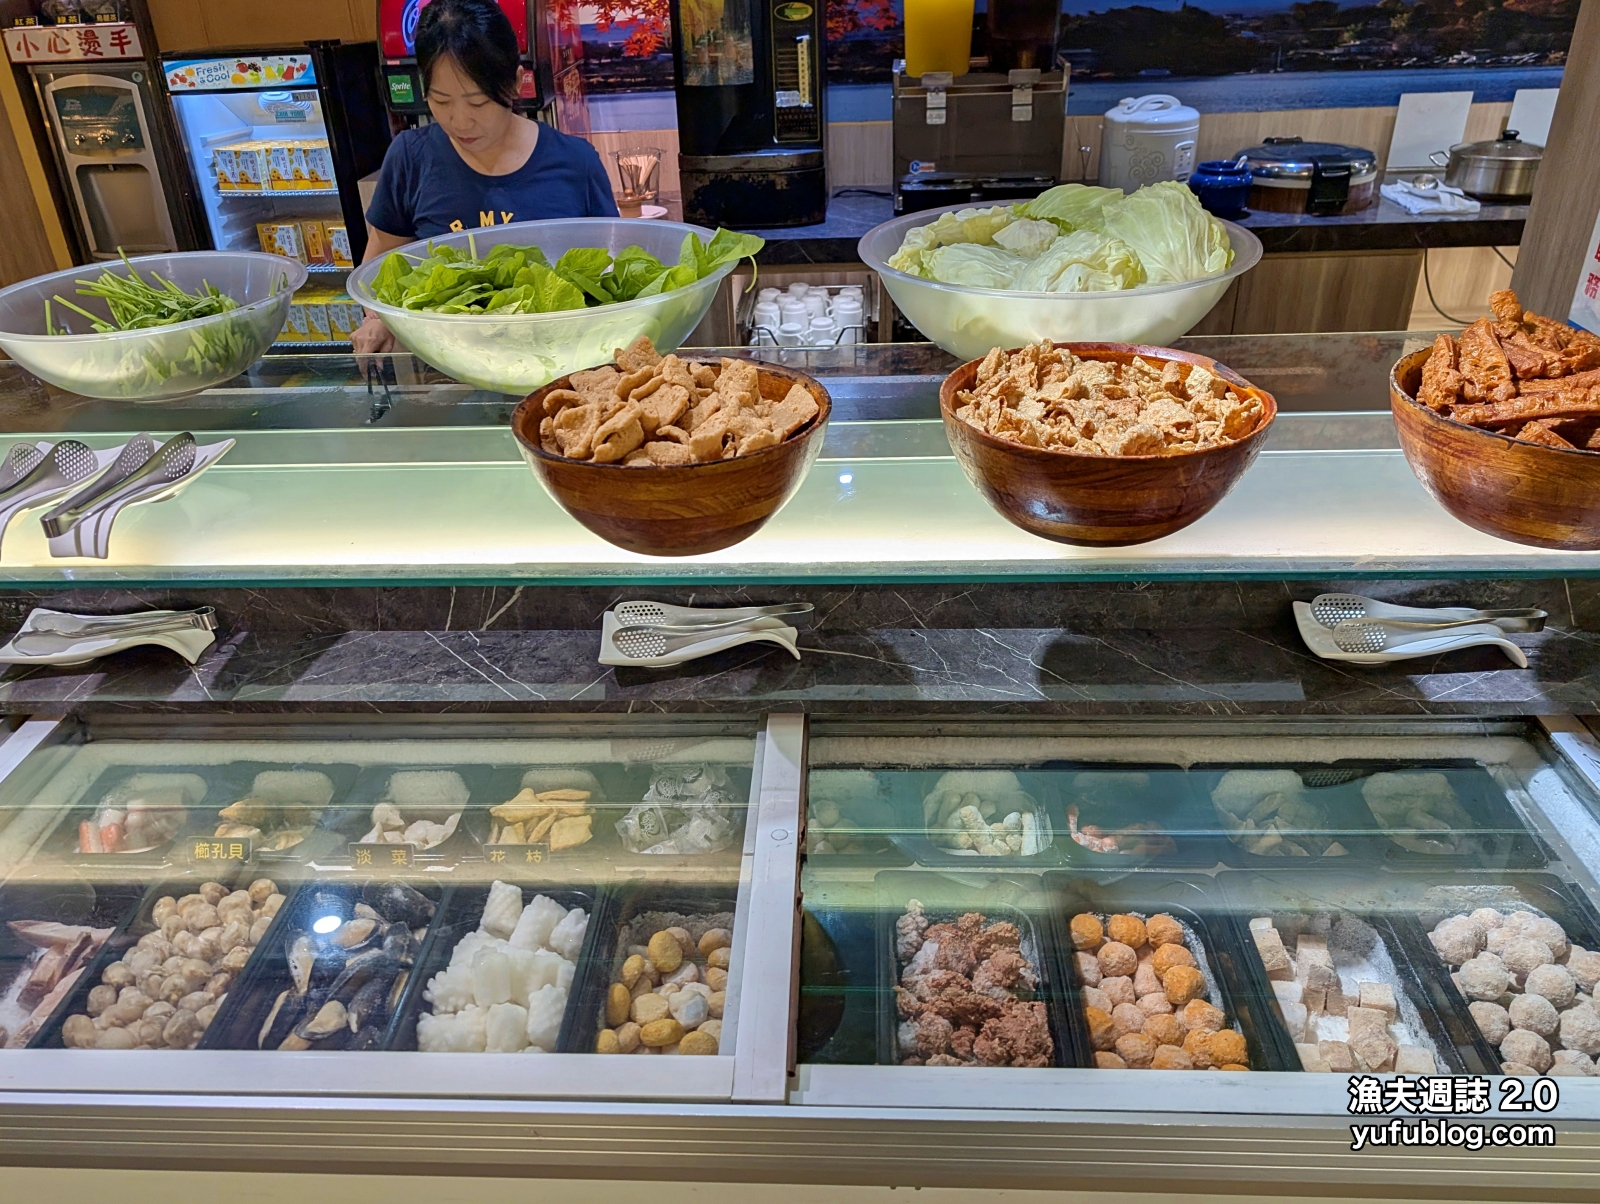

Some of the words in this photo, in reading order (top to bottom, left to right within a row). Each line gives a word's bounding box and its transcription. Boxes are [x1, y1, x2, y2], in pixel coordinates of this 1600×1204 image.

[14, 17, 35, 26] 紅茶
[57, 15, 78, 24] 綠茶
[16, 28, 132, 58] 小心燙手
[196, 62, 226, 77] Fresh
[391, 81, 411, 92] Sprite
[356, 848, 408, 866] 淡菜
[489, 849, 542, 864] 花枝
